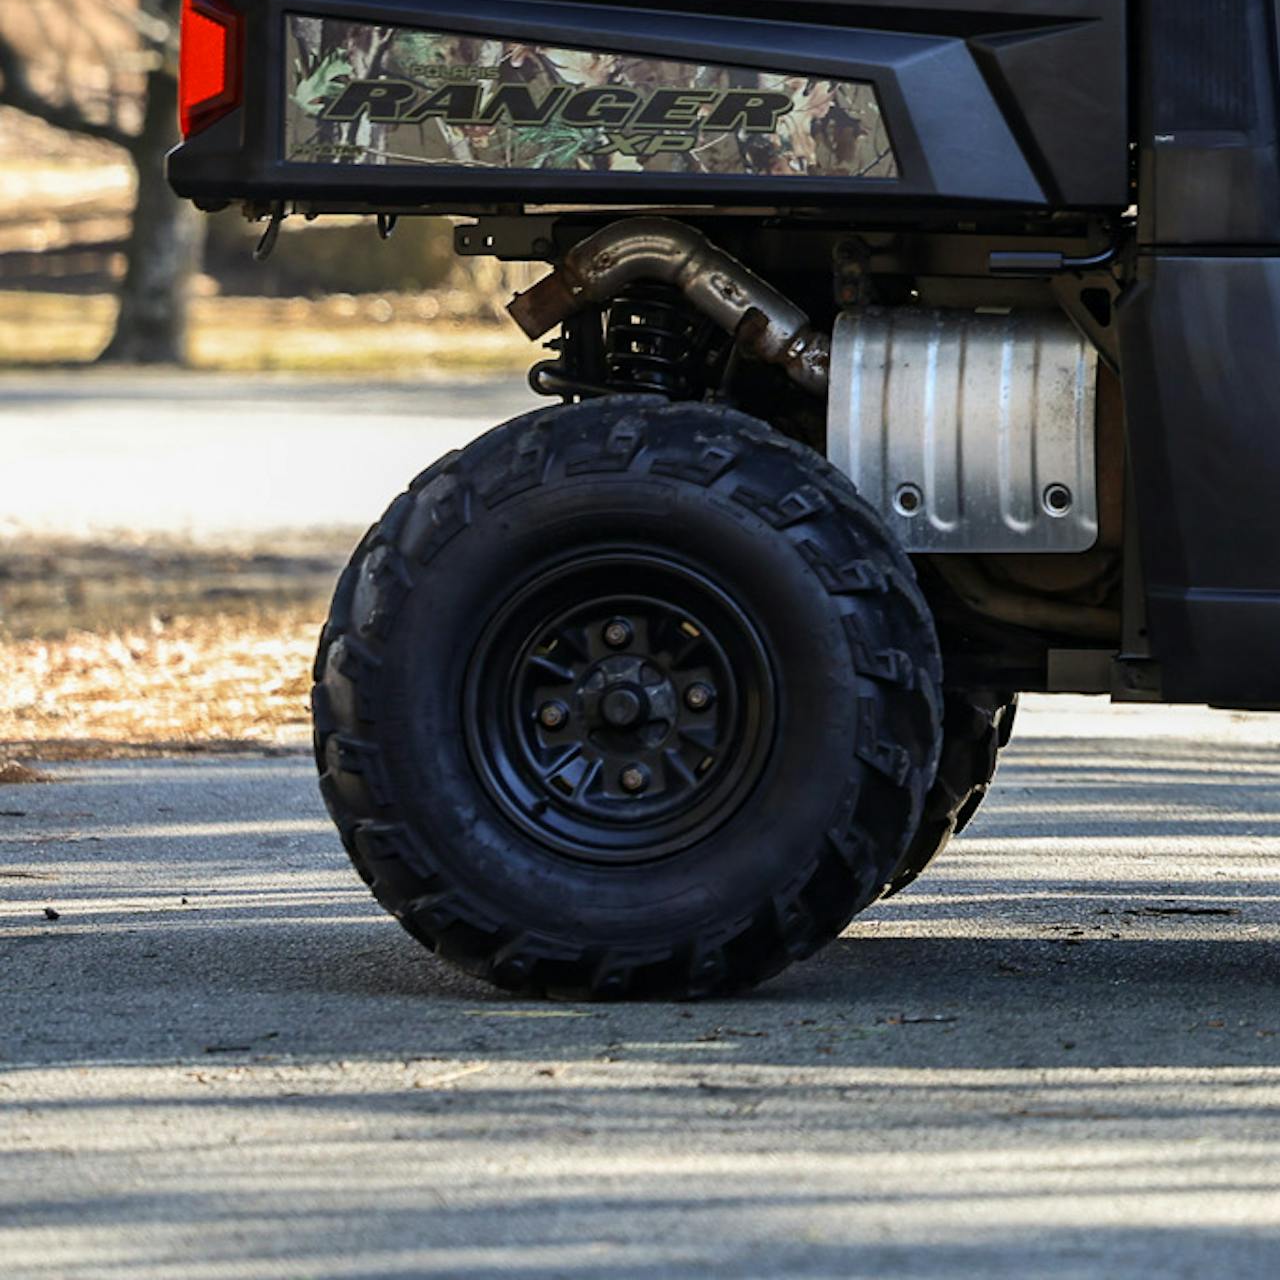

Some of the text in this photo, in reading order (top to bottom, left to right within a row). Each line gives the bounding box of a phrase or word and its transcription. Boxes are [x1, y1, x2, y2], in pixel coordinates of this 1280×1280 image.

[410, 65, 500, 79] POLARIS
[322, 78, 794, 133] RANGER
[590, 132, 697, 157] XP
